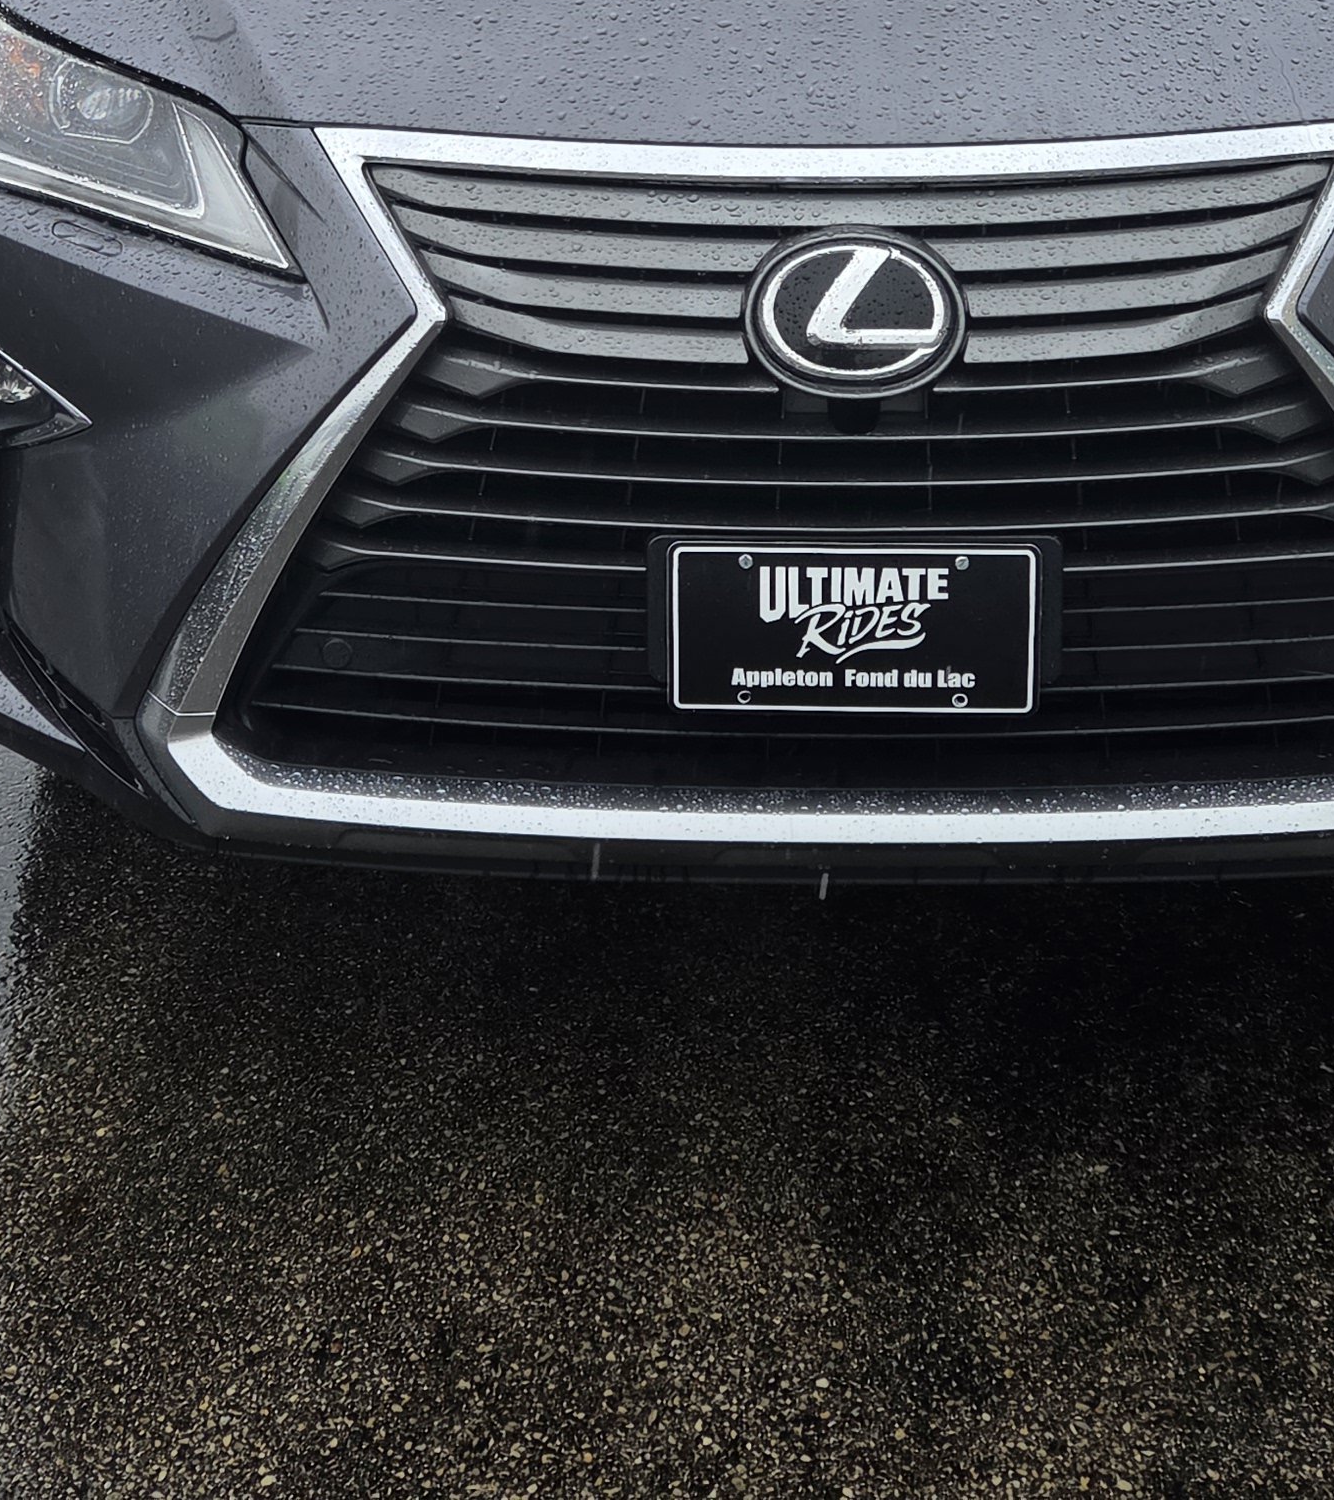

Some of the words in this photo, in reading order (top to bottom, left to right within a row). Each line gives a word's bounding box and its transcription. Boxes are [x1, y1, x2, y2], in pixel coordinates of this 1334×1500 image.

[759, 566, 949, 623] ULTIMATE
[731, 667, 833, 688] Appleton
[844, 668, 898, 688] Fond
[903, 669, 932, 688] du
[936, 668, 976, 689] Lac
